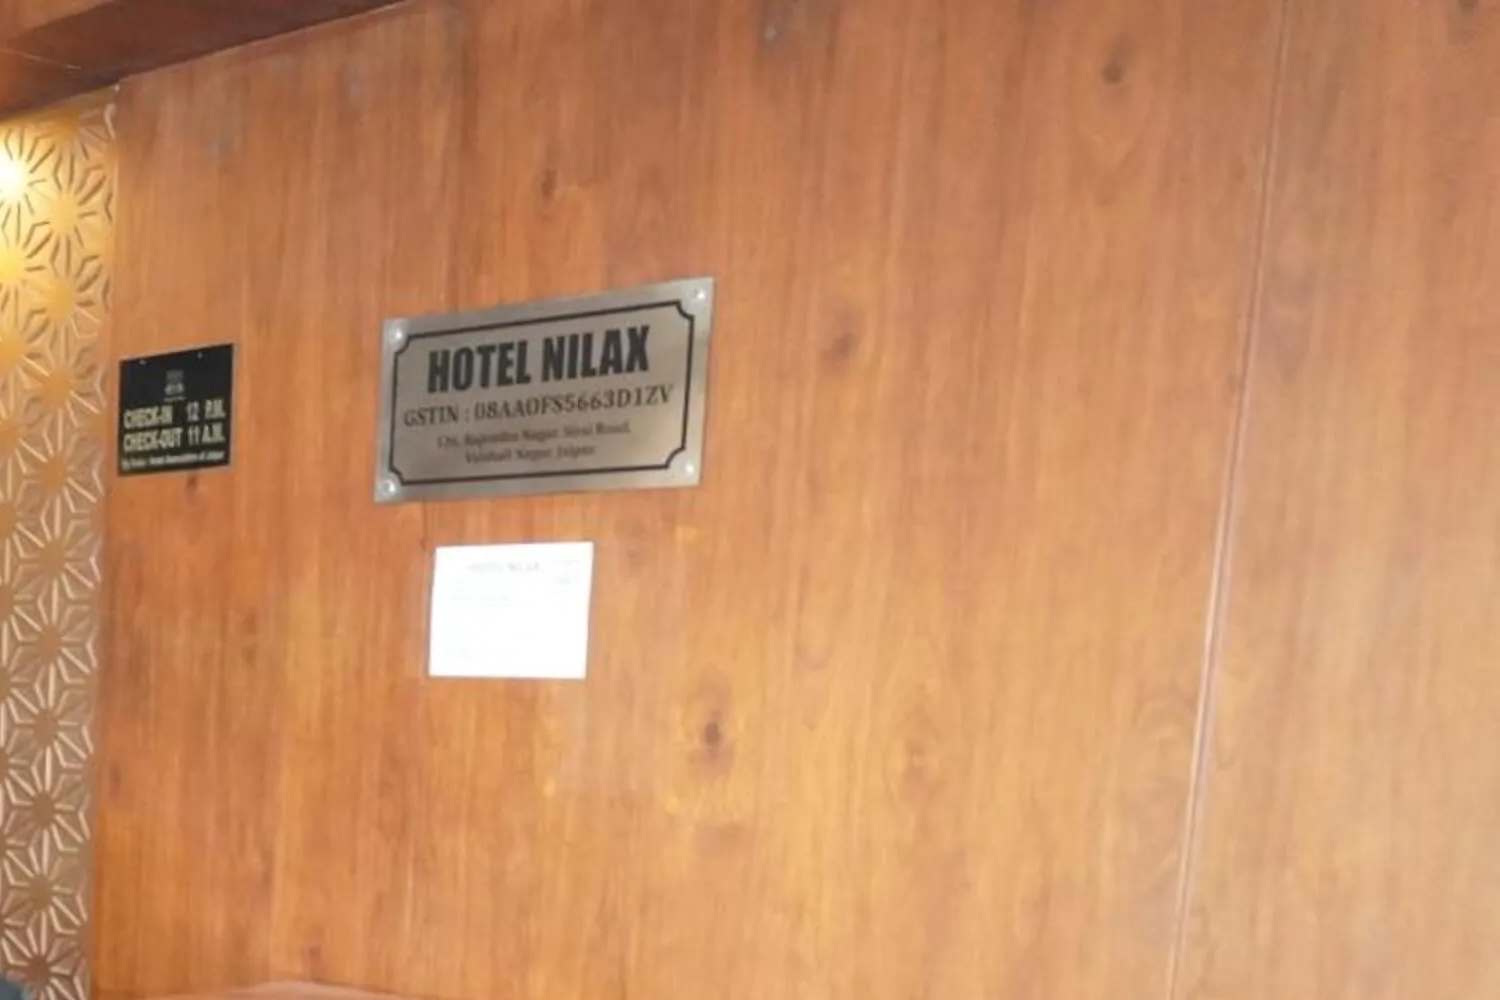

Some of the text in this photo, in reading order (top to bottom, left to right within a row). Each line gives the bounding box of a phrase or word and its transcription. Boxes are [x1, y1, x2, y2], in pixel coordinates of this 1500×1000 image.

[428, 325, 650, 393] HOTEL NILAX
[403, 406, 460, 427] GSTIN
[124, 427, 183, 453] CHECK-OUT
